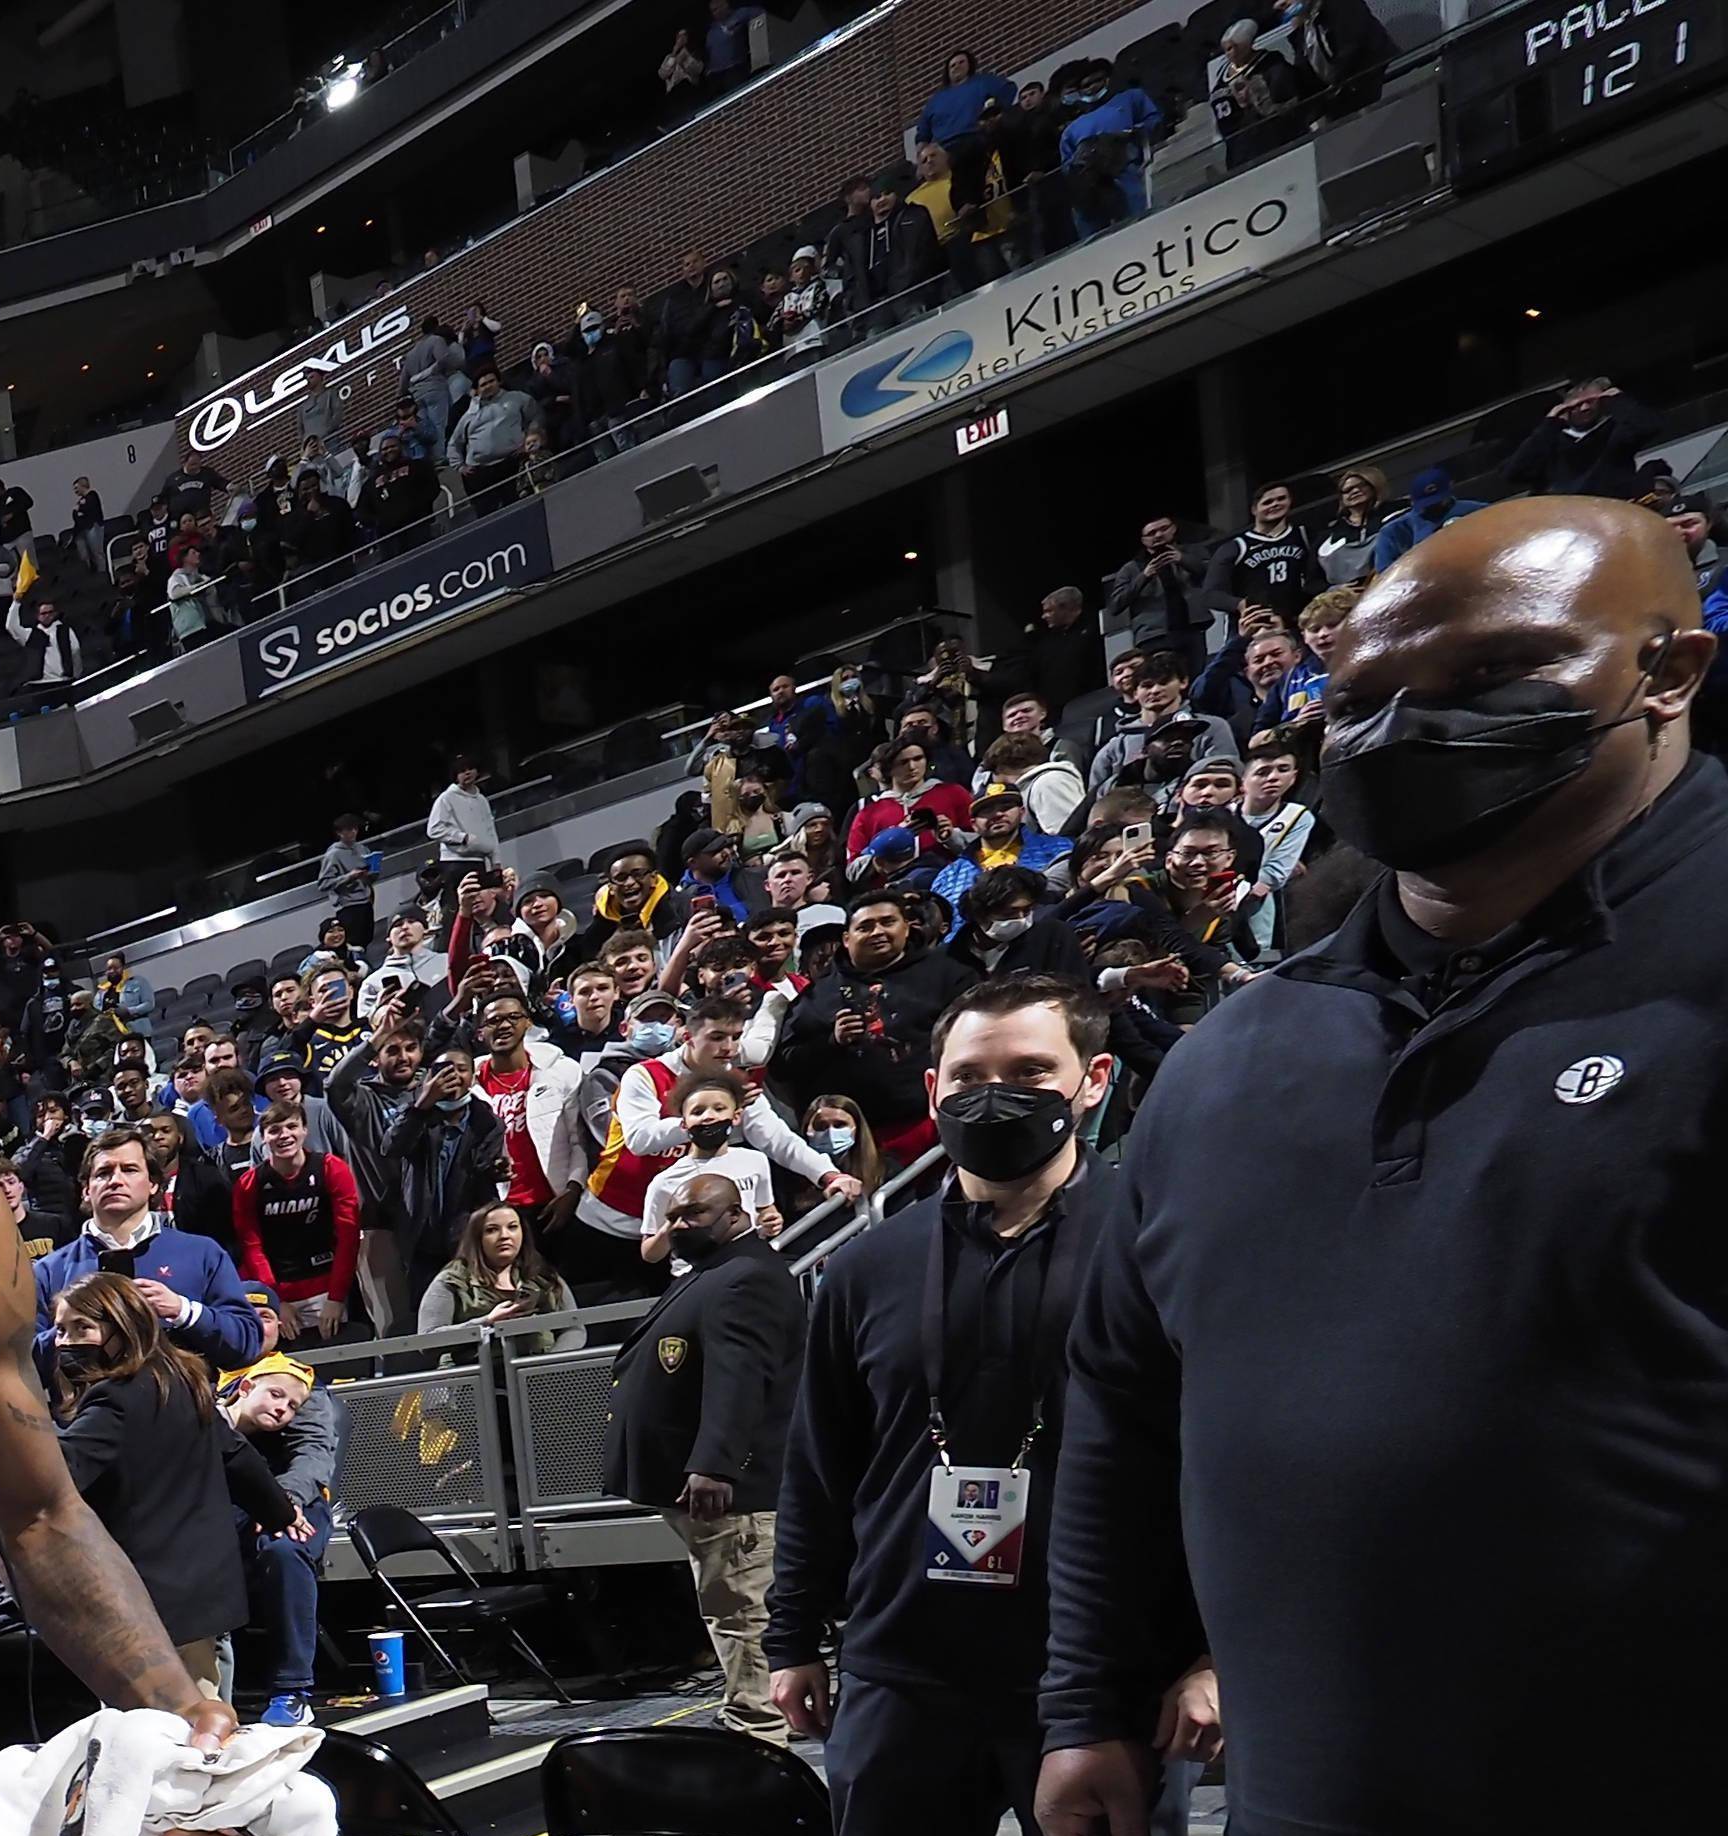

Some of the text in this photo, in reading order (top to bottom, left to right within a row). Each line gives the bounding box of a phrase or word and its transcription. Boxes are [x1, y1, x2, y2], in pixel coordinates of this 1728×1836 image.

[1004, 198, 1288, 346] Kinetico
[244, 304, 413, 413] LEXUS
[927, 270, 1197, 401] water systems
[966, 415, 1001, 444] EXIT
[315, 542, 527, 656] SOCIOS.com
[1266, 560, 1289, 585] 13
[264, 1195, 320, 1217] MIAMI
